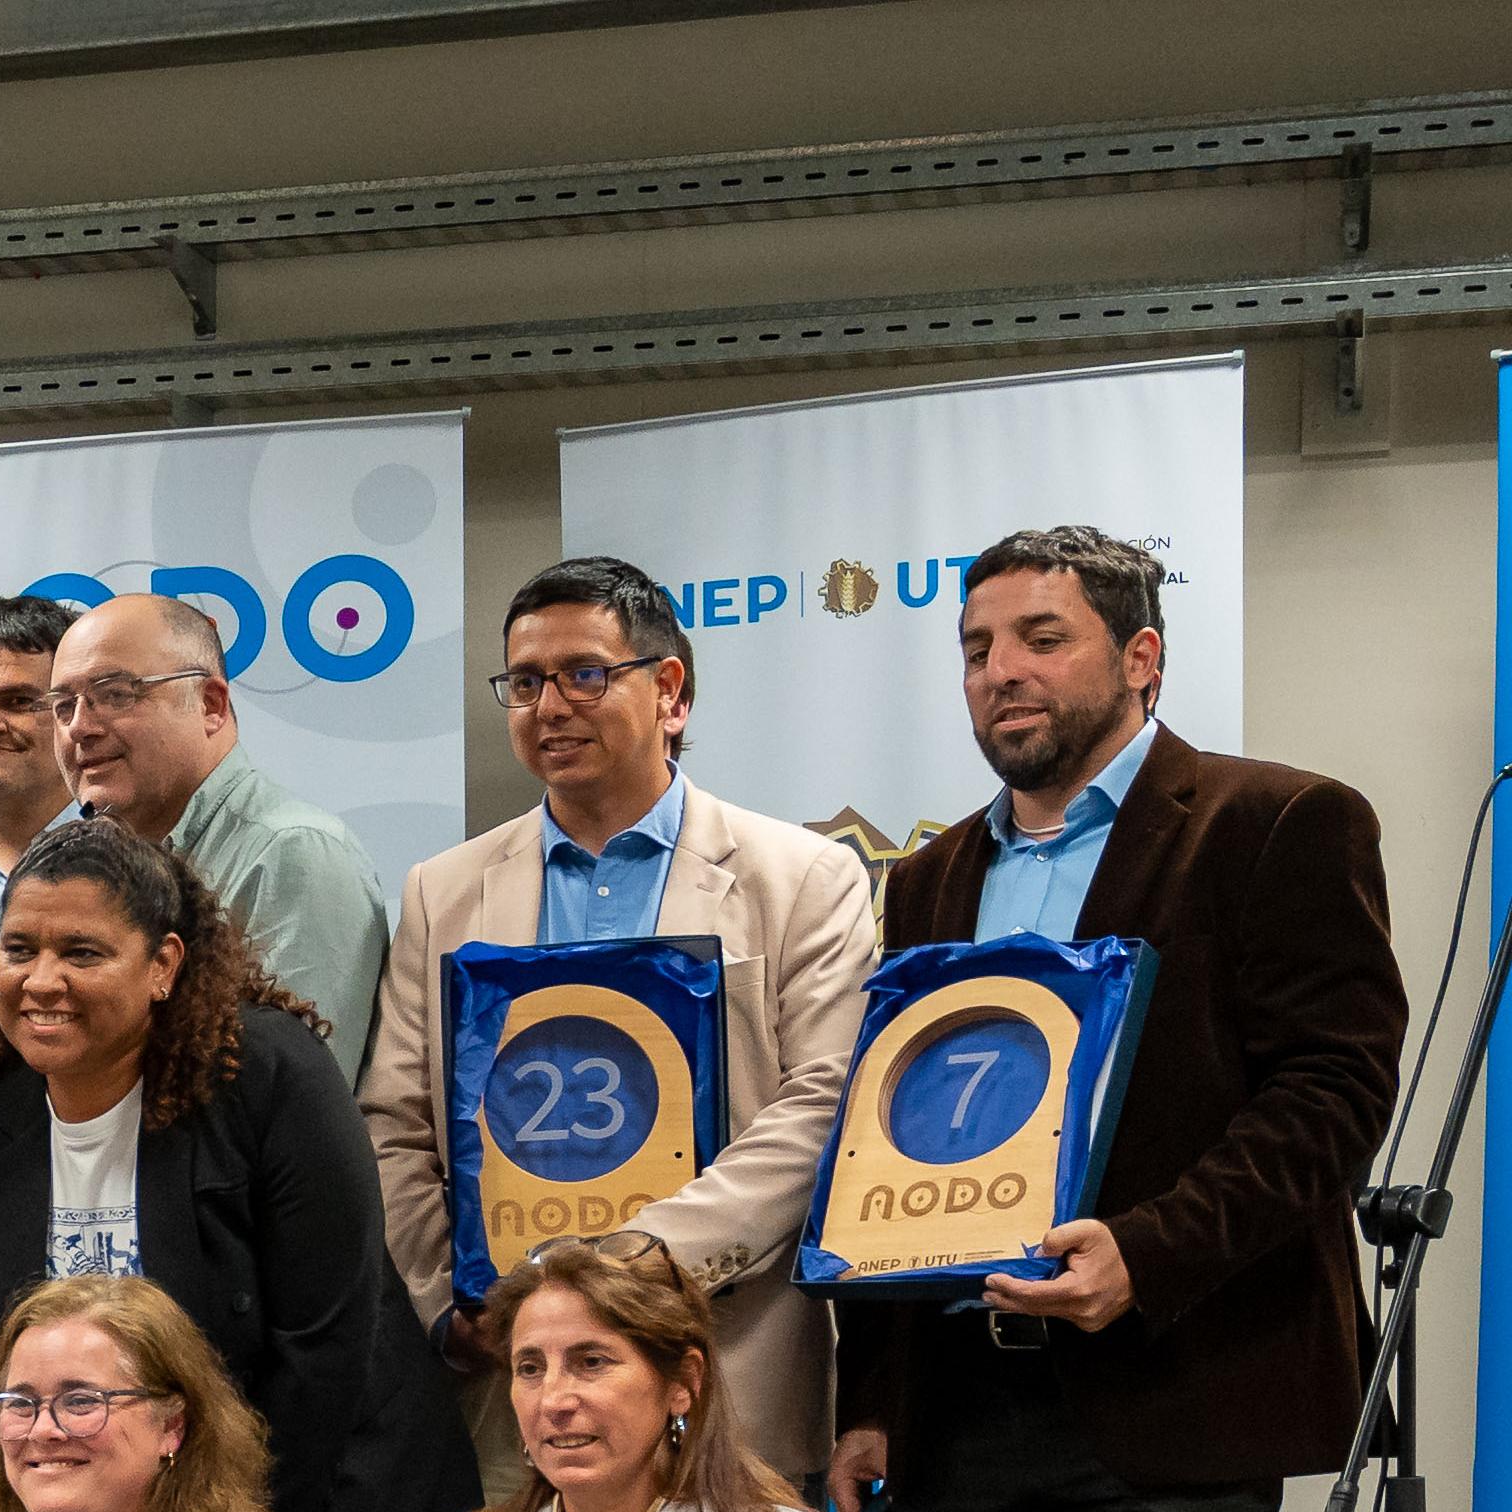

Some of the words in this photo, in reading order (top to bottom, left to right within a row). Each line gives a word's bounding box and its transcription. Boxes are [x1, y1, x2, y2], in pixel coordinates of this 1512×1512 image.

[659, 574, 789, 630] NEP
[896, 555, 984, 609] UT
[515, 1057, 625, 1142] 23
[945, 1050, 1000, 1129] 7
[859, 1172, 1027, 1222] NODO
[857, 1258, 901, 1273] ANEP
[924, 1253, 957, 1266] UTU
